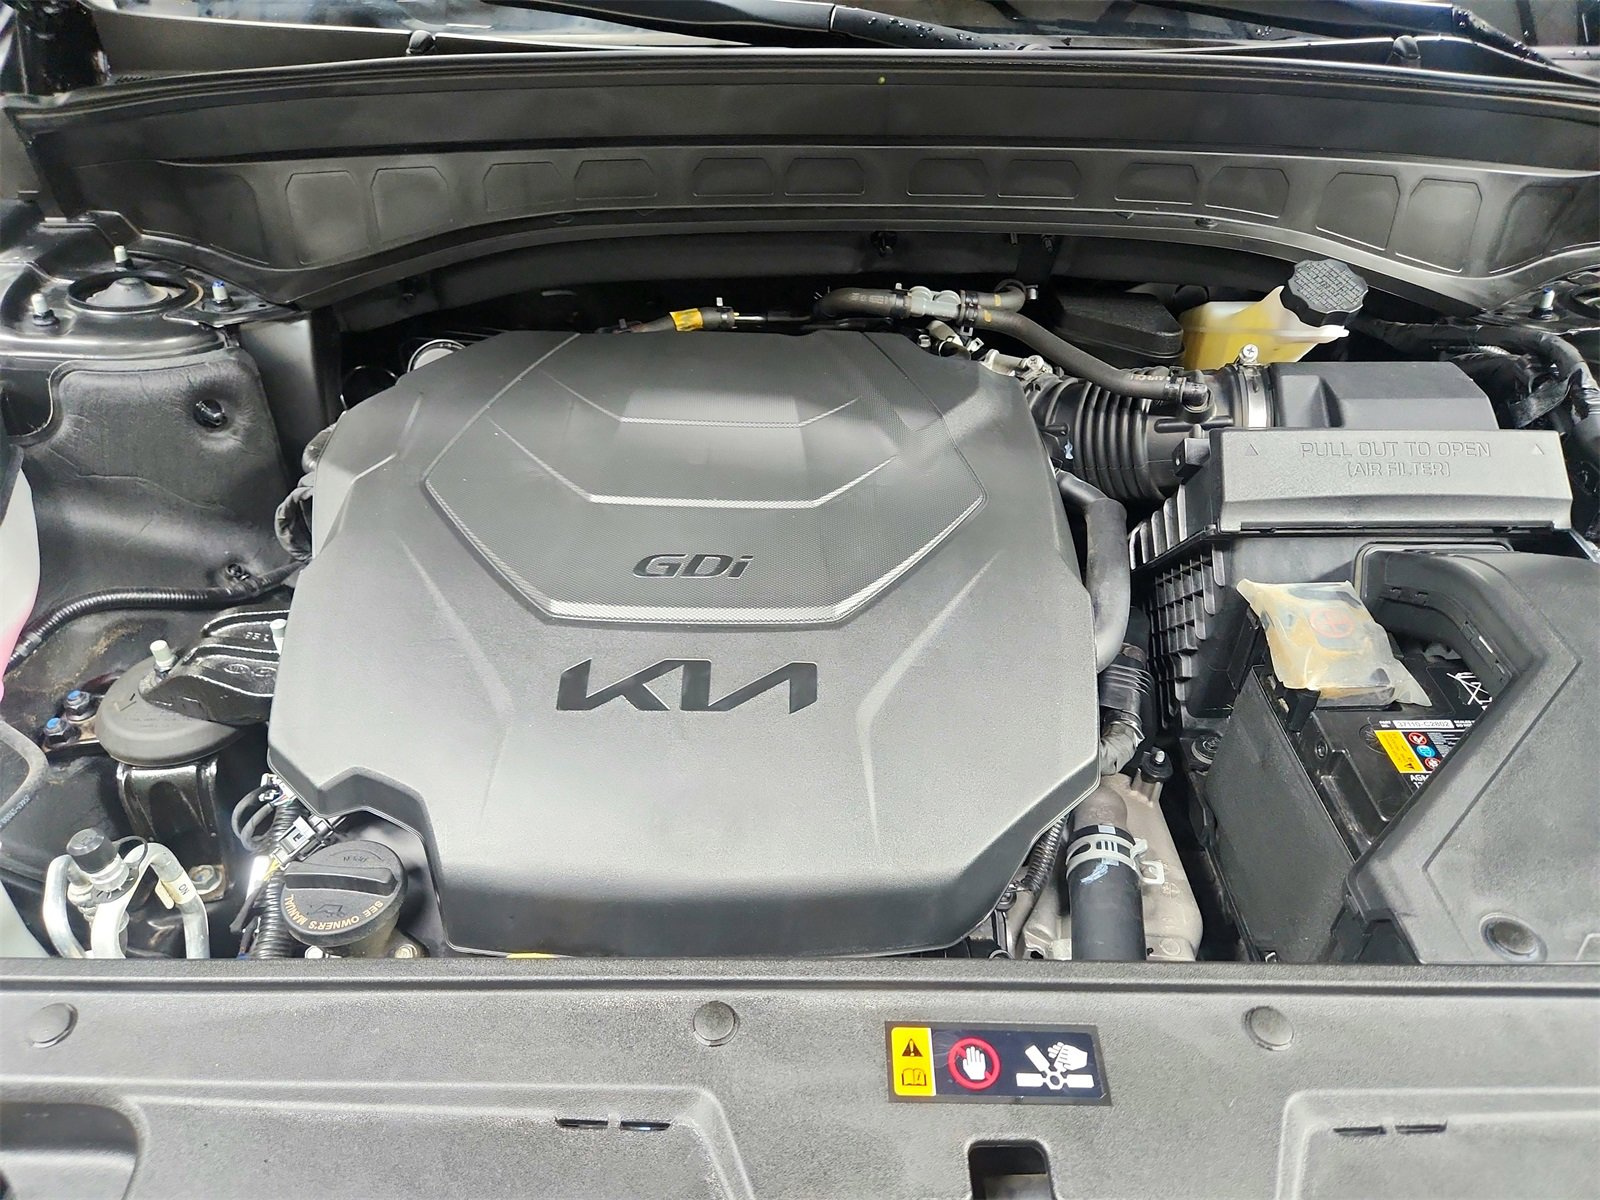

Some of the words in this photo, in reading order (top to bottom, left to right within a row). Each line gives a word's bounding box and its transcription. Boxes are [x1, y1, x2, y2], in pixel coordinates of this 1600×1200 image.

[1300, 442, 1352, 457] PULL
[1358, 441, 1398, 457] OUT
[1404, 441, 1432, 457] TO
[1437, 441, 1492, 457] OPEN
[1347, 461, 1383, 477] (AIR
[1387, 461, 1451, 477] FILTER)
[632, 553, 754, 579] GDi
[556, 658, 818, 715] KIA
[284, 893, 309, 926] MANUAL
[362, 899, 384, 918] SEE
[308, 915, 360, 931] OWNER'S
